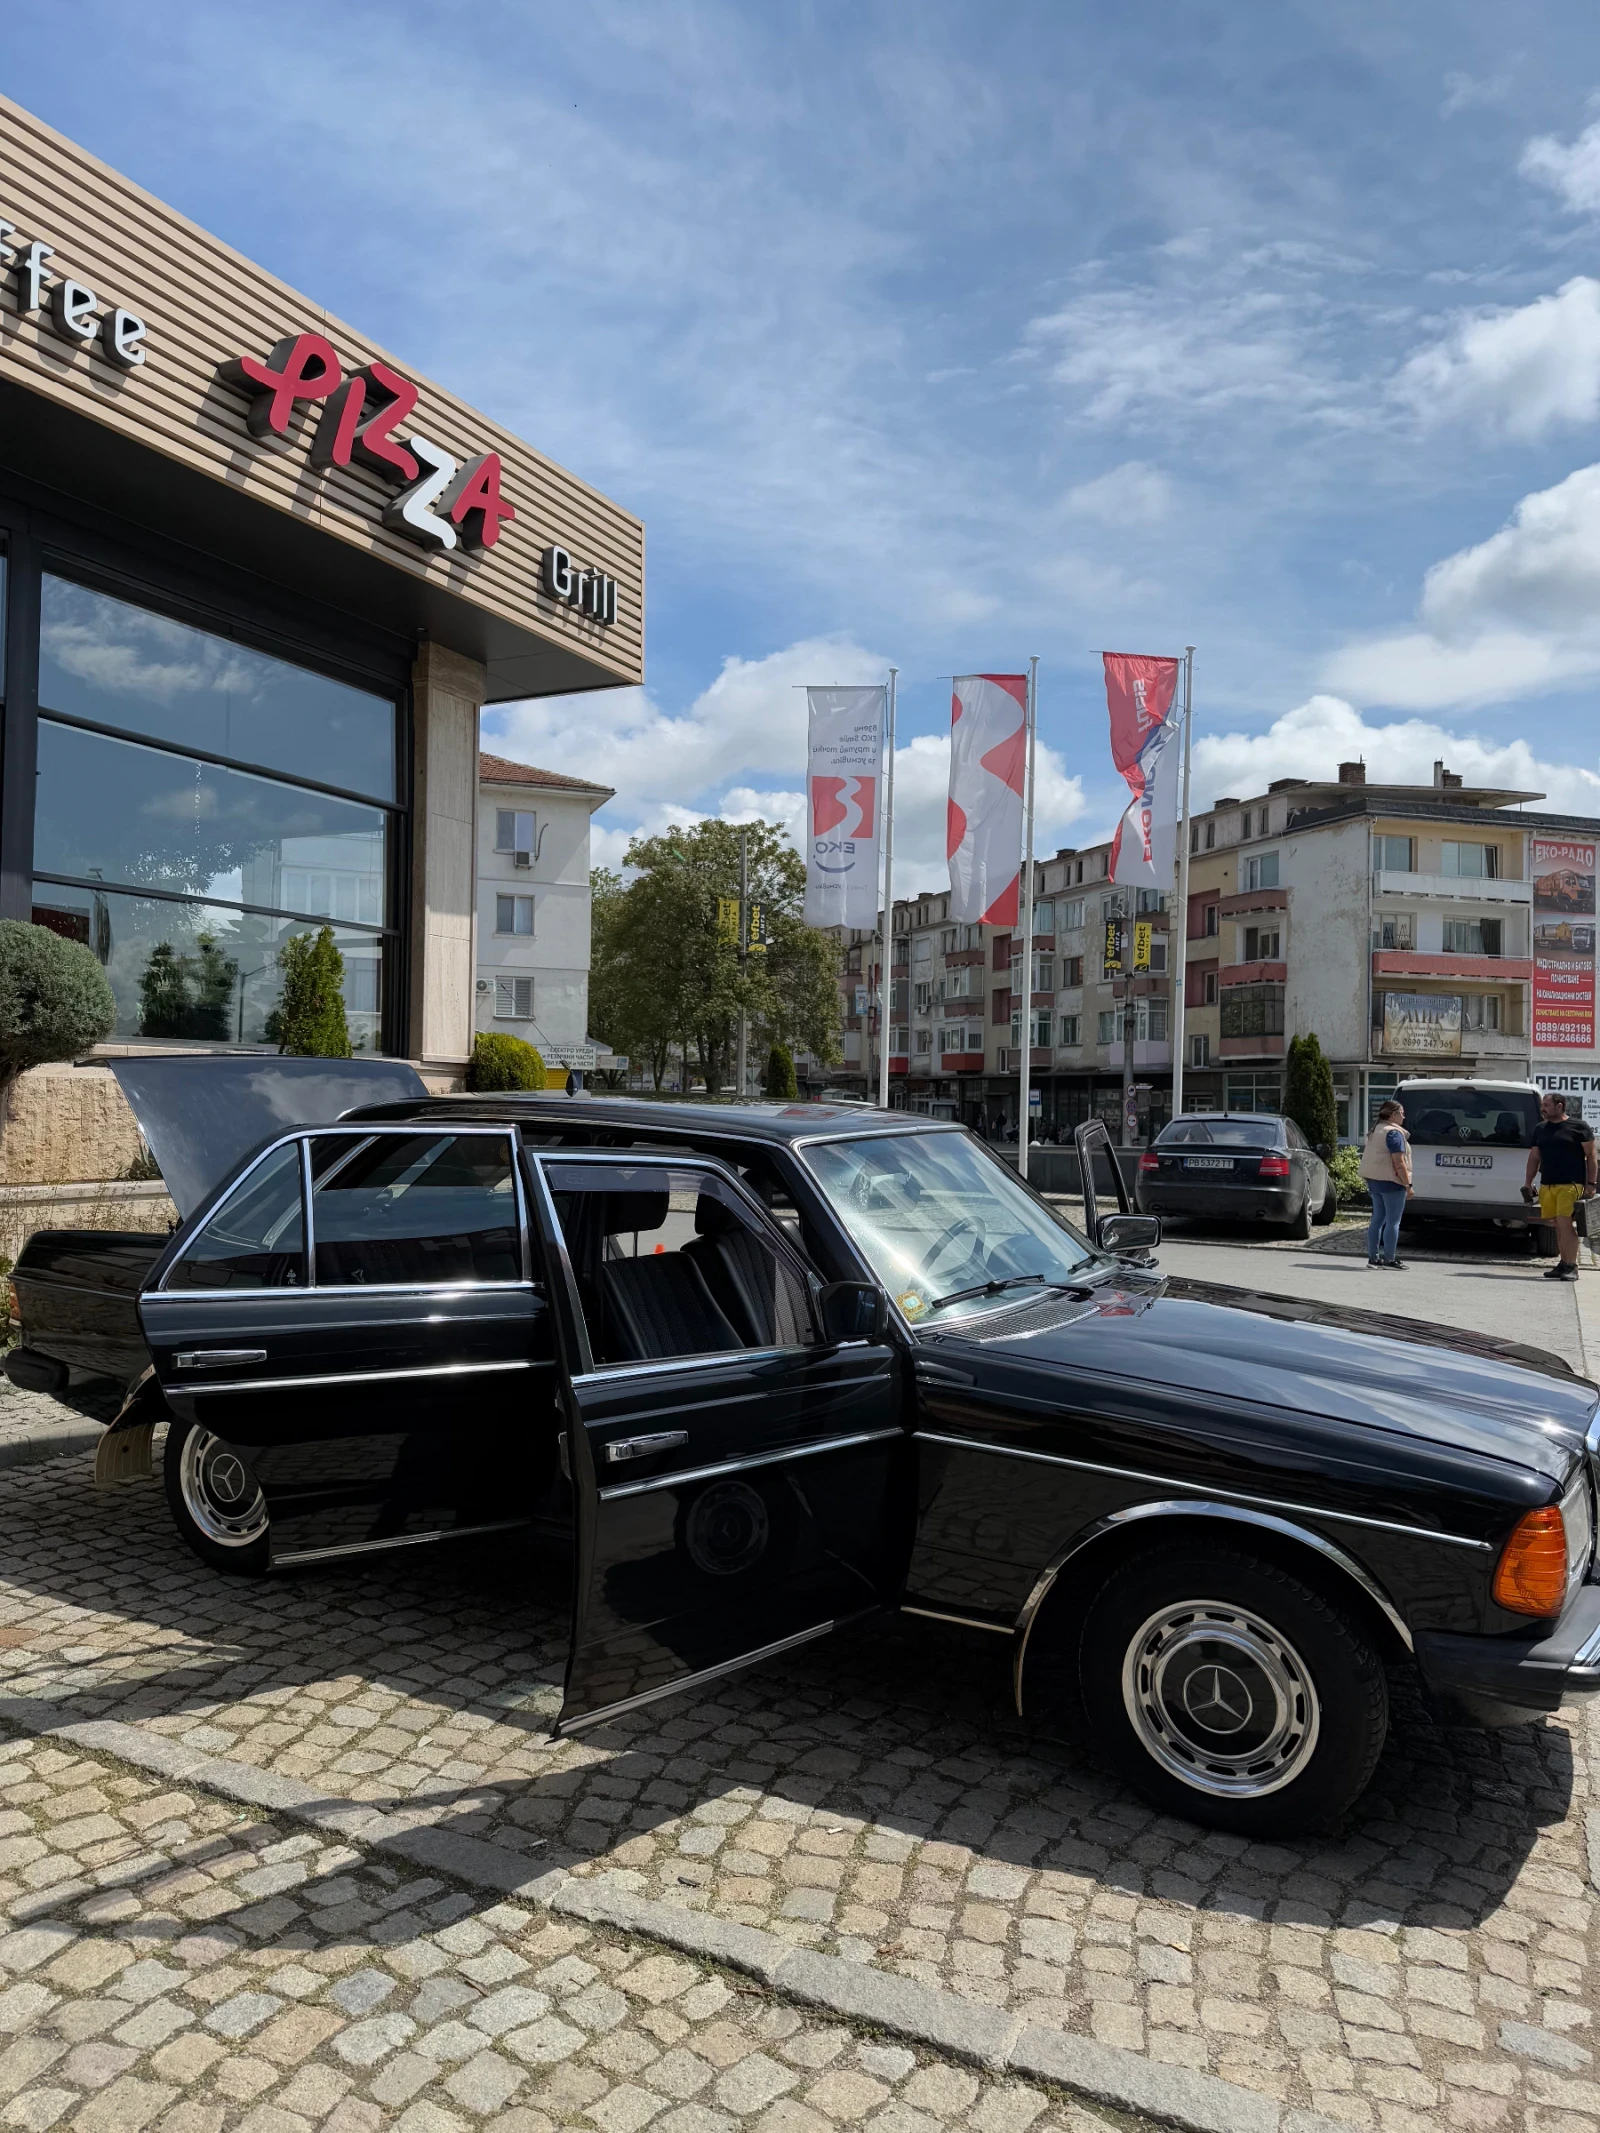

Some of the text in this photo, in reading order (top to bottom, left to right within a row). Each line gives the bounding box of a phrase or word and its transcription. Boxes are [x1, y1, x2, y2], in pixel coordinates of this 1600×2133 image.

[238, 333, 516, 550] PIZZA
[550, 545, 618, 625] Grill
[1535, 843, 1594, 868] ЕКО-РАДО
[751, 904, 761, 941] efbet
[1106, 922, 1115, 959] efbet
[1137, 925, 1146, 960] efbet
[1550, 973, 1580, 985] ПОЧИСТВАНЕ
[1535, 1022, 1592, 1033] 0889/492196
[1402, 1038, 1453, 1049] 0899 247 365
[1535, 1032, 1592, 1044] 0896/246666
[1535, 1075, 1600, 1091] ПЕЛЕТИ
[1200, 1158, 1220, 1168] 5372
[1222, 1159, 1234, 1168] TT
[1442, 1155, 1490, 1166] CT 6141 TK
